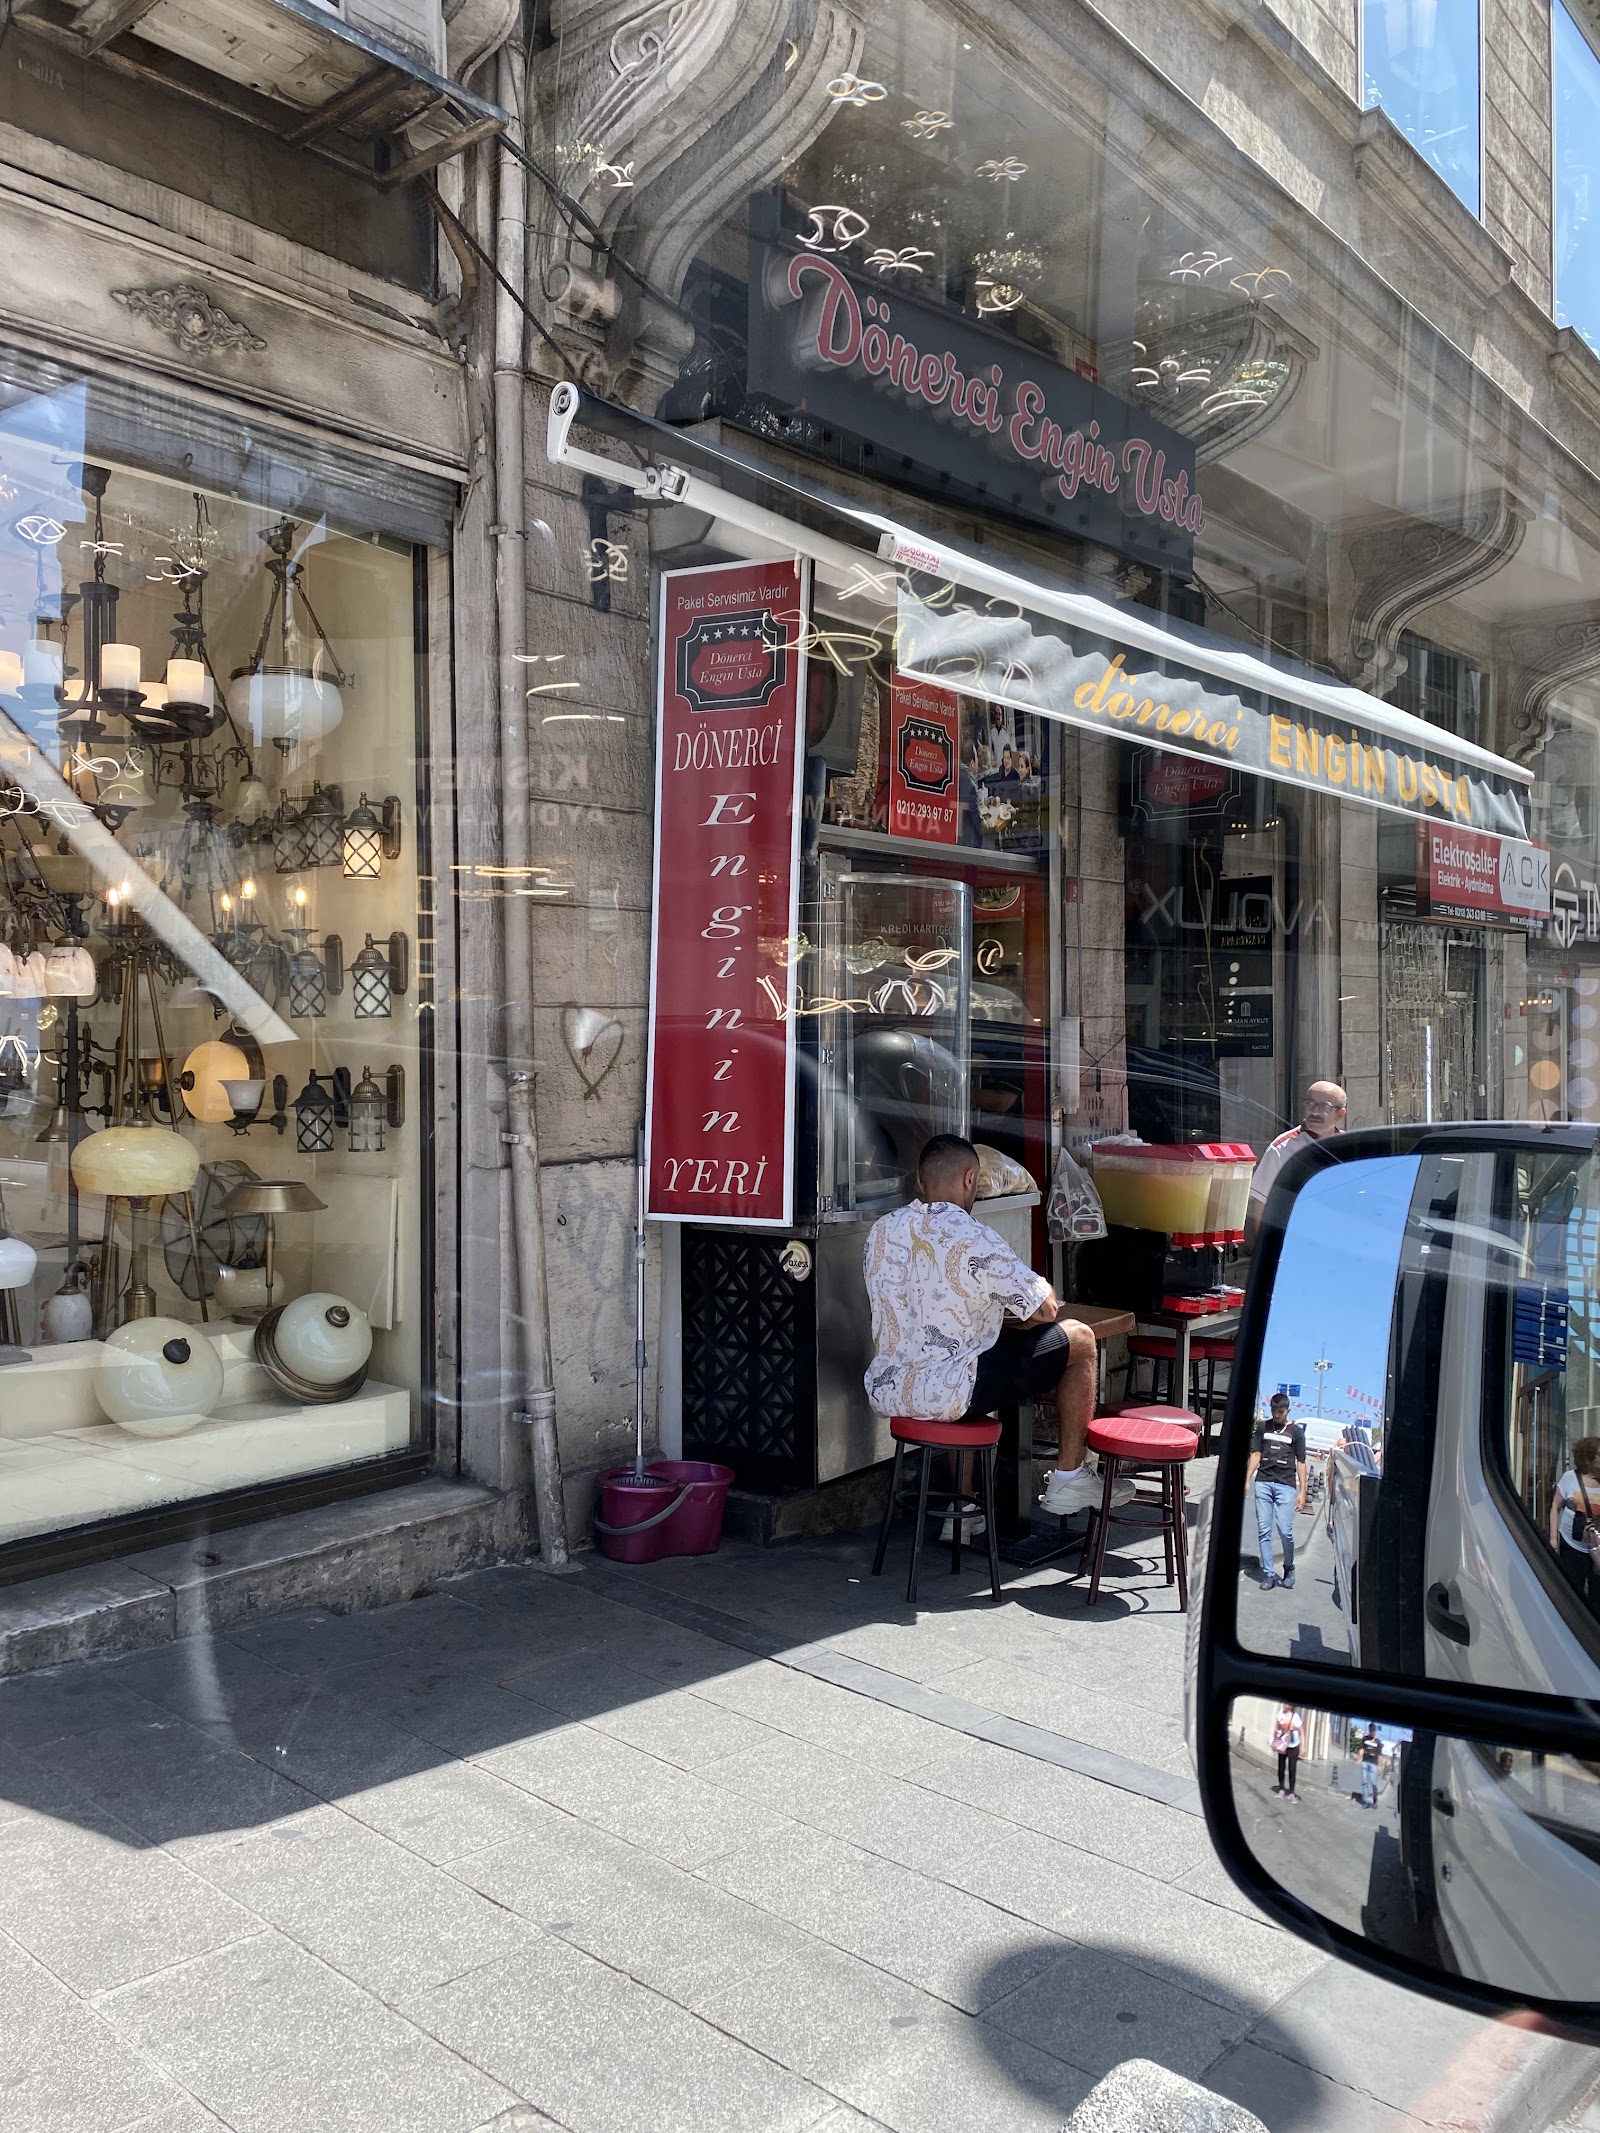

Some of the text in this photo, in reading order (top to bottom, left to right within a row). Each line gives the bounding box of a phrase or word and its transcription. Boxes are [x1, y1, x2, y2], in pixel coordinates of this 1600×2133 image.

[787, 252, 1206, 536] Dönerci Engin Usta
[677, 585, 789, 611] Paket Servisimiz Vardır
[710, 648, 753, 665] Dönerci
[700, 668, 763, 686] Engin Usta
[895, 688, 955, 718] Paket Servisimiz Vardır
[673, 718, 783, 772] DÖNERCİ
[1073, 653, 1473, 819] dönerci ENGİN USTA
[915, 745, 937, 760] Dönerci
[909, 758, 944, 775] Engin Usta
[1154, 778, 1219, 797] Engin Usta
[896, 799, 954, 823] 0212 293 97 87
[1432, 836, 1498, 876] Elektroşalter
[1438, 870, 1461, 889] Elektrik
[1464, 875, 1494, 895] Aydınlatma
[1503, 852, 1548, 892] ACK
[913, 923, 938, 935] KARTI
[663, 1155, 769, 1196] YERİ
[788, 1260, 809, 1268] axess
